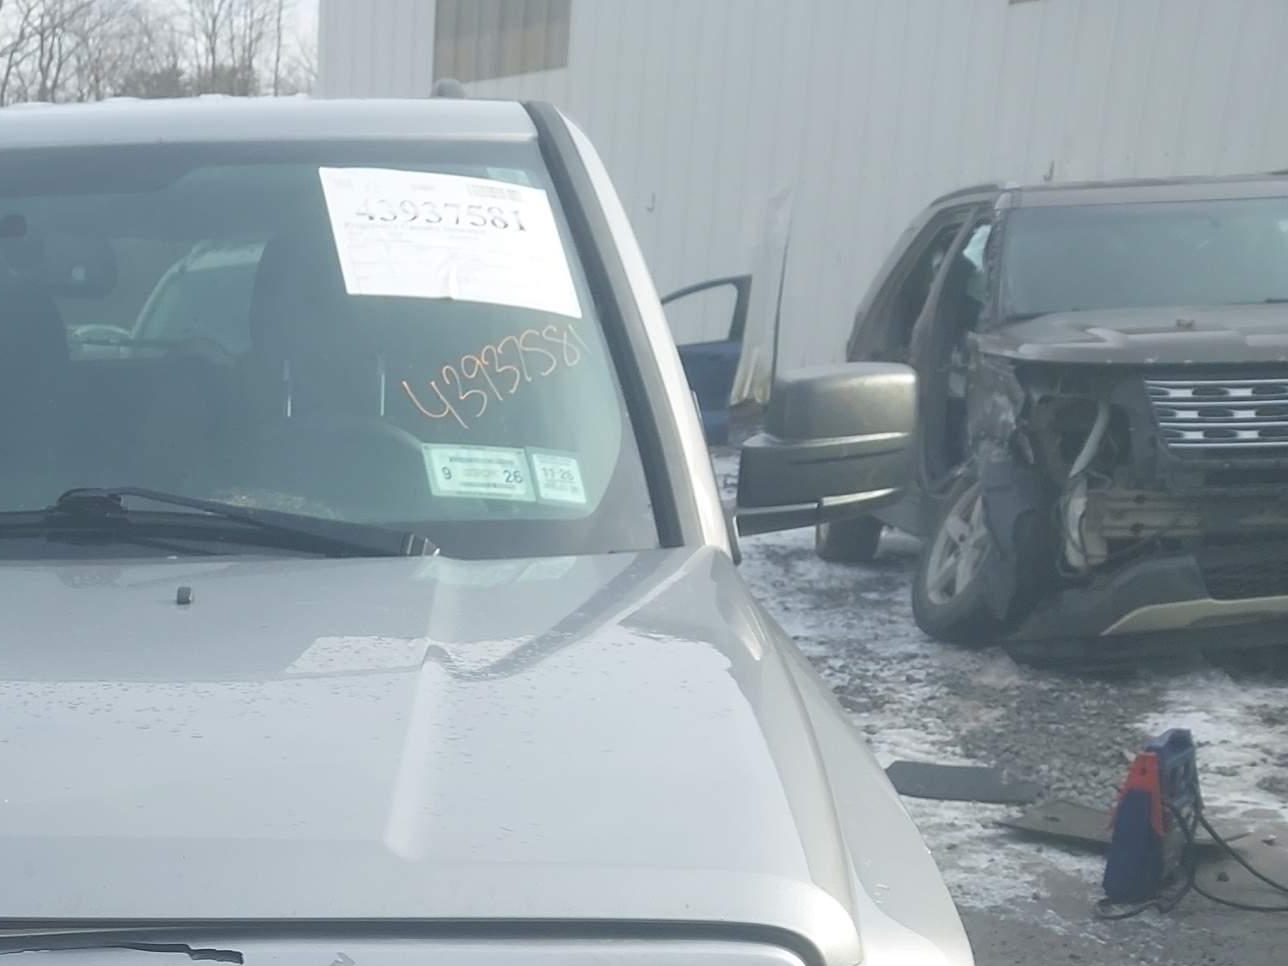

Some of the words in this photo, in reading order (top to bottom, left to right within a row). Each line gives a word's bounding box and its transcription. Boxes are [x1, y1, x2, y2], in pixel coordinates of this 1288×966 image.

[355, 197, 528, 232] 43937581
[401, 323, 592, 429] 43937581
[441, 466, 453, 481] 9
